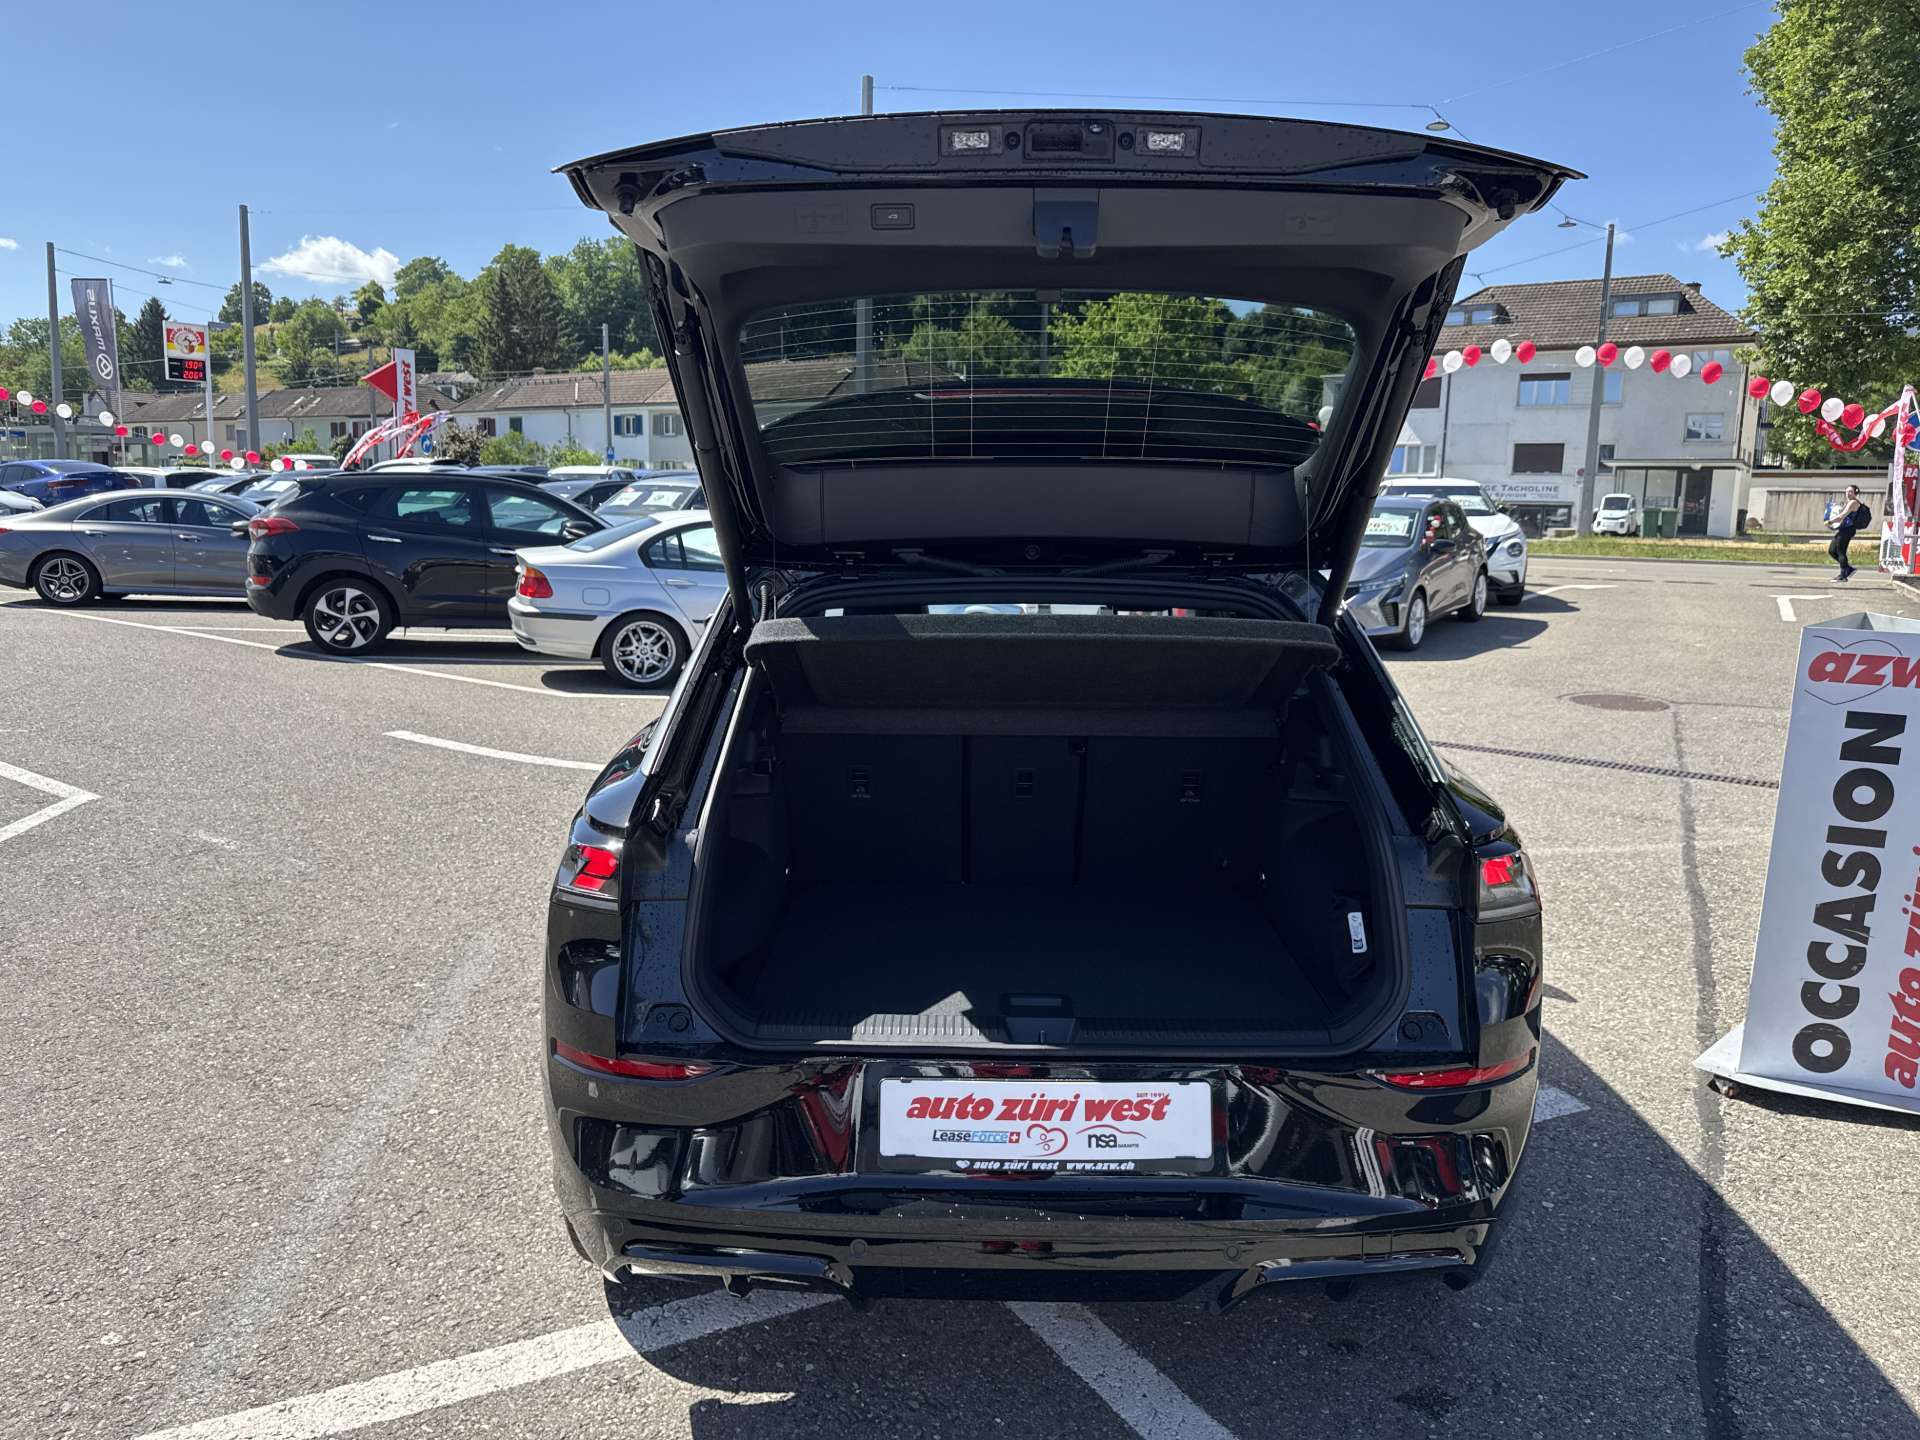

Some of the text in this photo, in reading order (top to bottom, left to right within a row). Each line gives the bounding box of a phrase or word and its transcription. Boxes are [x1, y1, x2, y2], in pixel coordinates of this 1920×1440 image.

[1501, 484, 1560, 492] TACHOLINE
[1792, 710, 1908, 1074] OCCASION
[1884, 967, 1920, 1089] auto
[906, 1092, 1172, 1122] auto züri west
[1087, 1133, 1118, 1149] nsa
[973, 1159, 1136, 1171] auto züri west www.azw.ch
